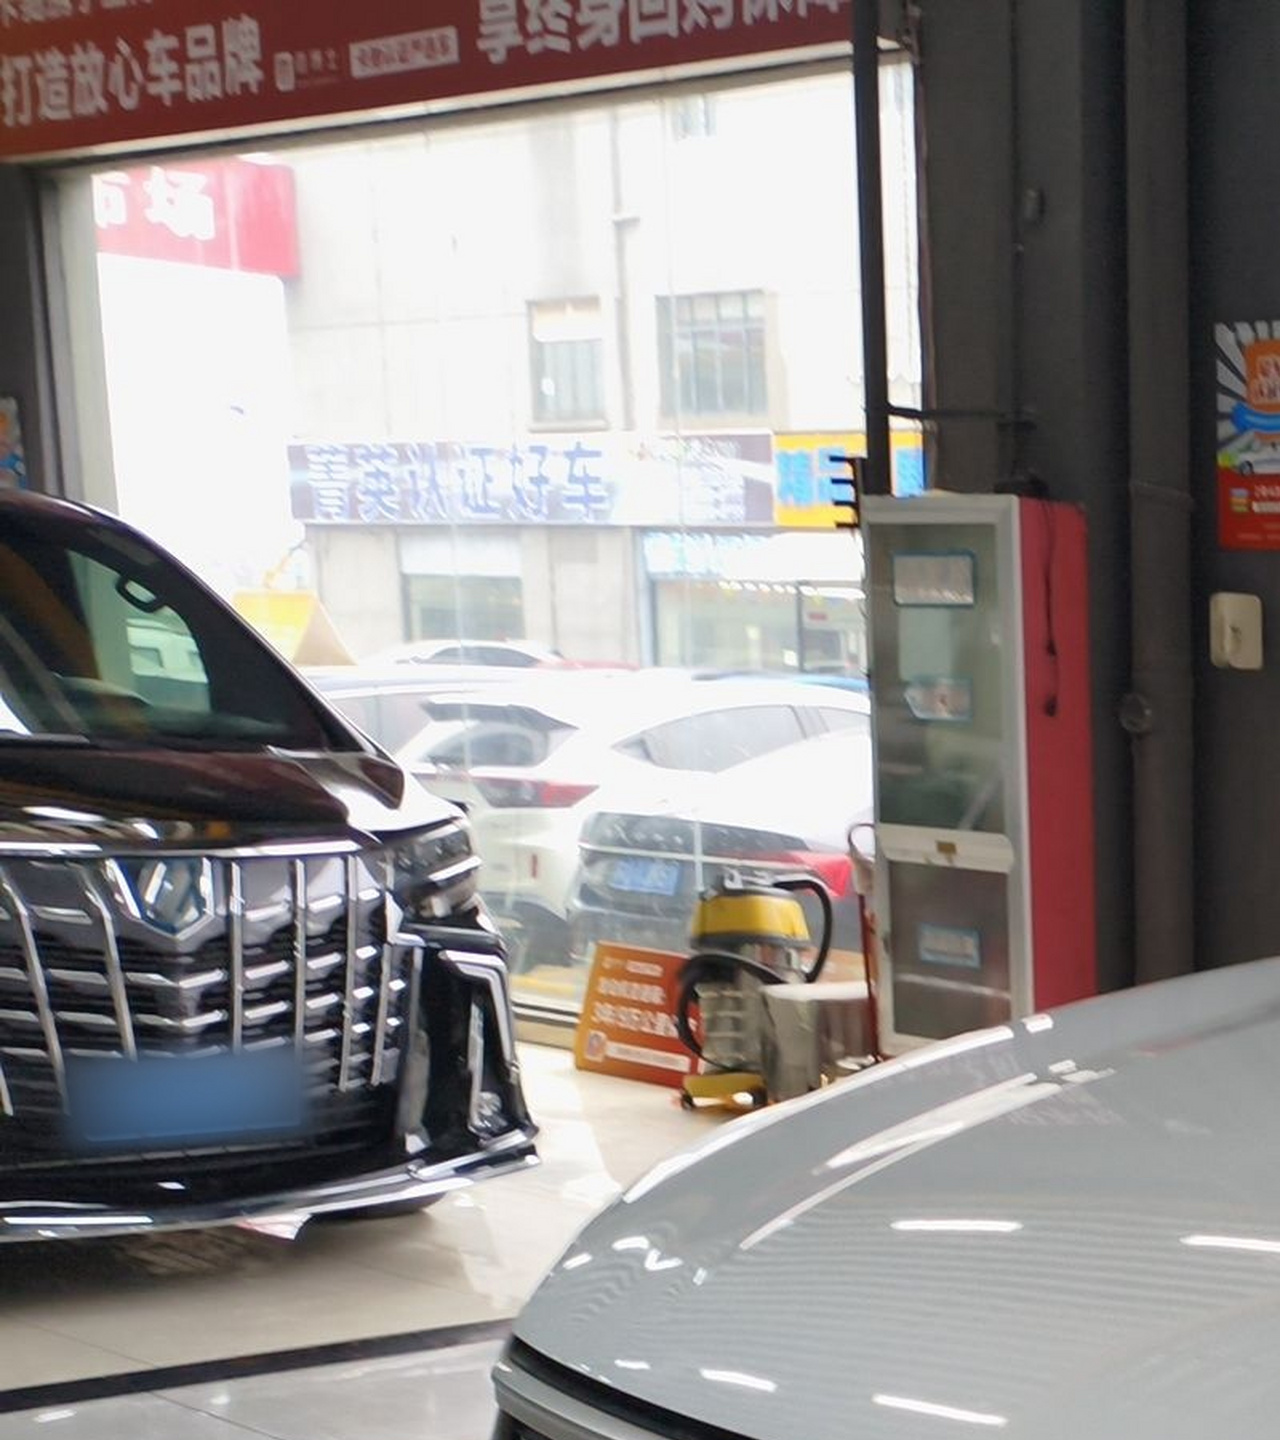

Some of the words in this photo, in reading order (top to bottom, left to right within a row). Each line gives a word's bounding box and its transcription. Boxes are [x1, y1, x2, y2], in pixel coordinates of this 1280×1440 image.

[1, 13, 265, 127] 打造放心车品牌
